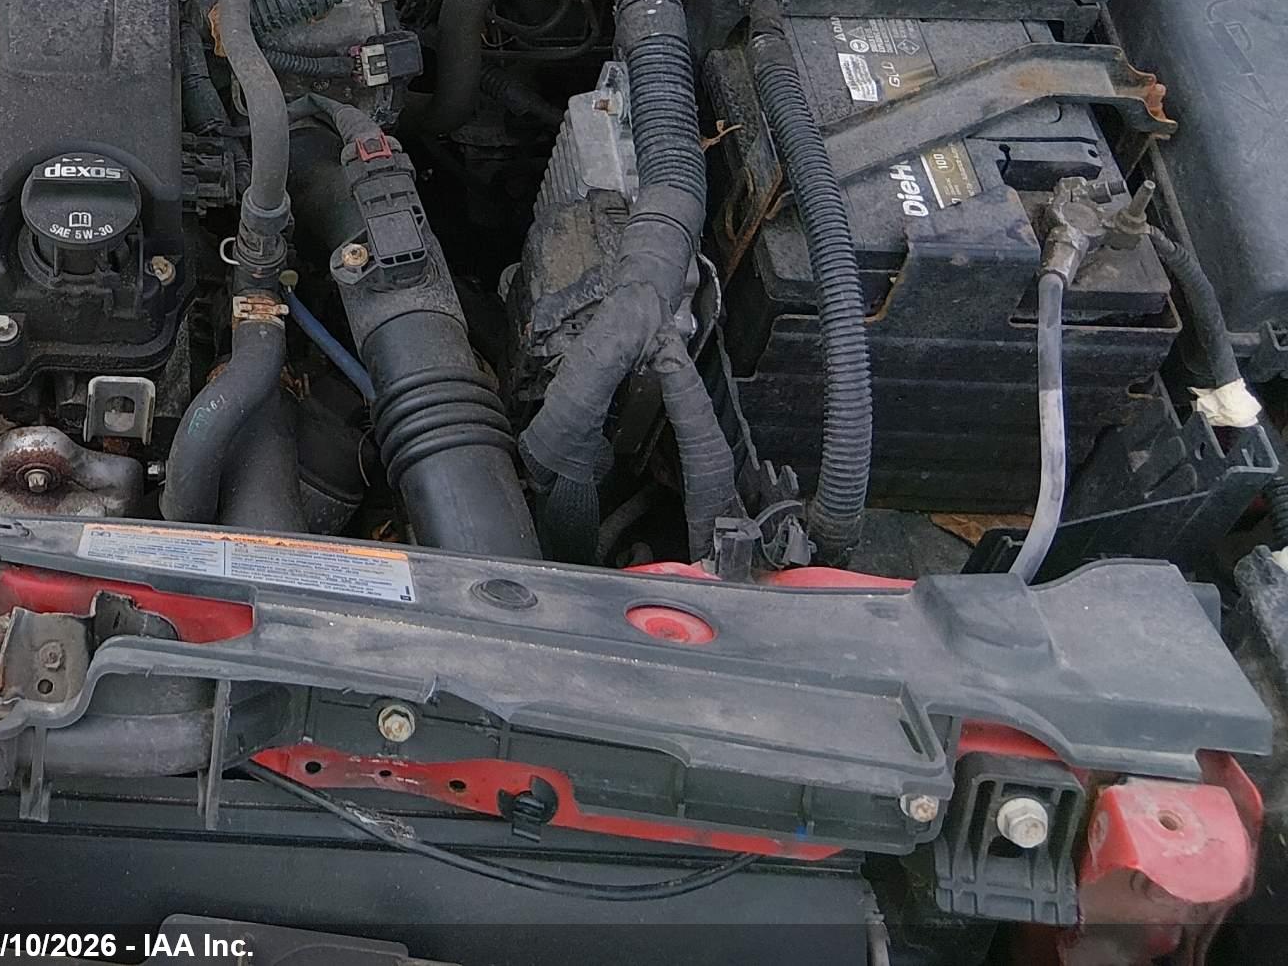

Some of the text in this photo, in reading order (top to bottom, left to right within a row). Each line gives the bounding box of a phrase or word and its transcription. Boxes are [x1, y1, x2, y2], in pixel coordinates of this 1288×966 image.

[932, 152, 949, 170] 100
[44, 163, 121, 179] dexos
[888, 161, 929, 217] DieH
[49, 223, 113, 240] SAE 5W-30
